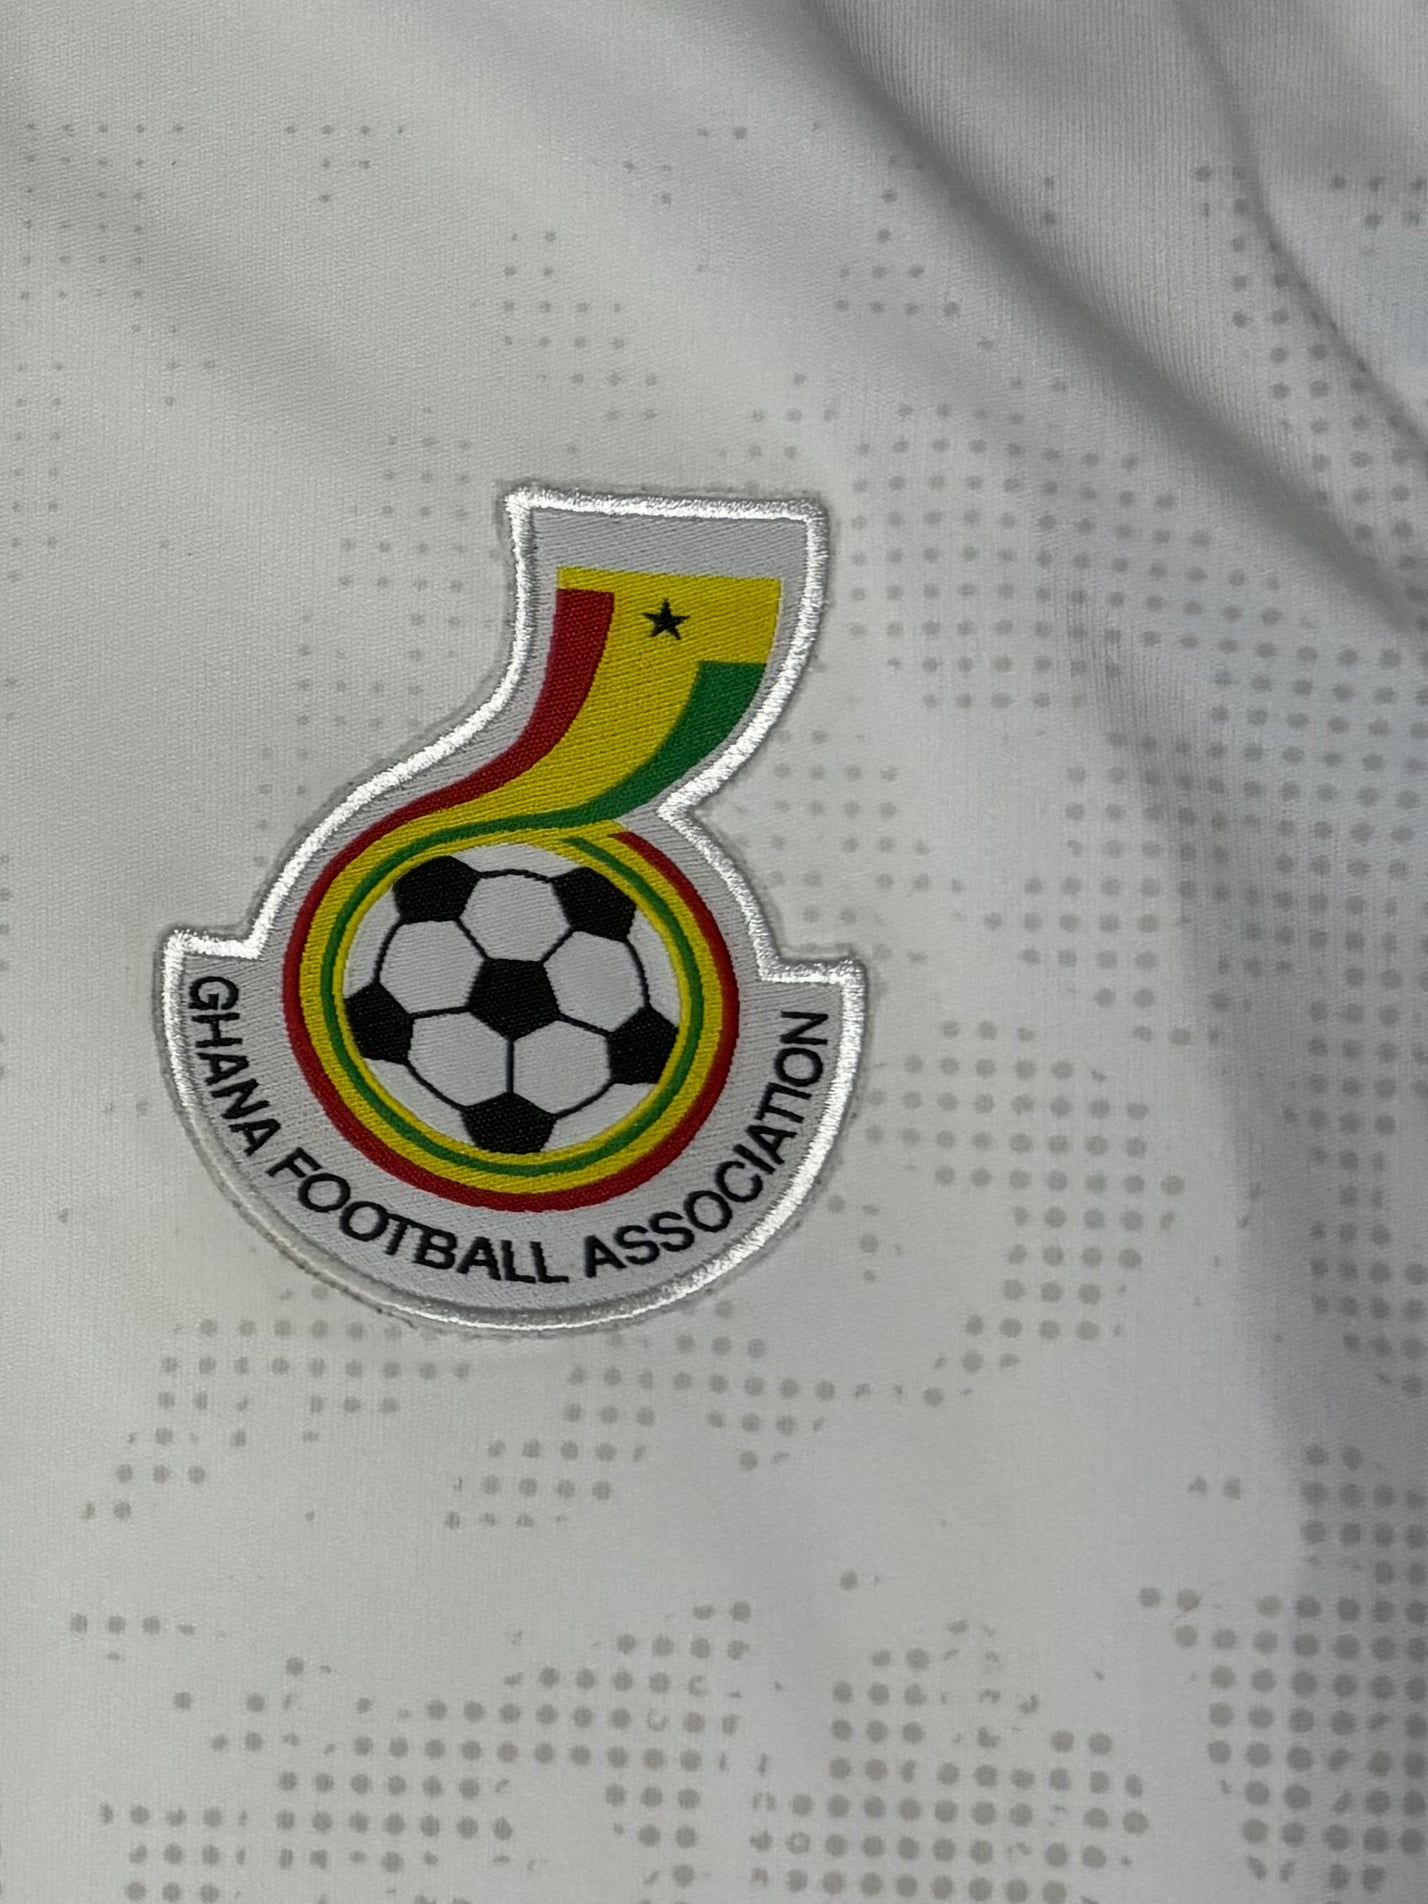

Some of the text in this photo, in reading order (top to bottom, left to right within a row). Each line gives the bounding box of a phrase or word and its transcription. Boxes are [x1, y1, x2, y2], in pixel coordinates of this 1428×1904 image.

[187, 974, 830, 1285] GHANA FOOTBALL ASSOCIATION
